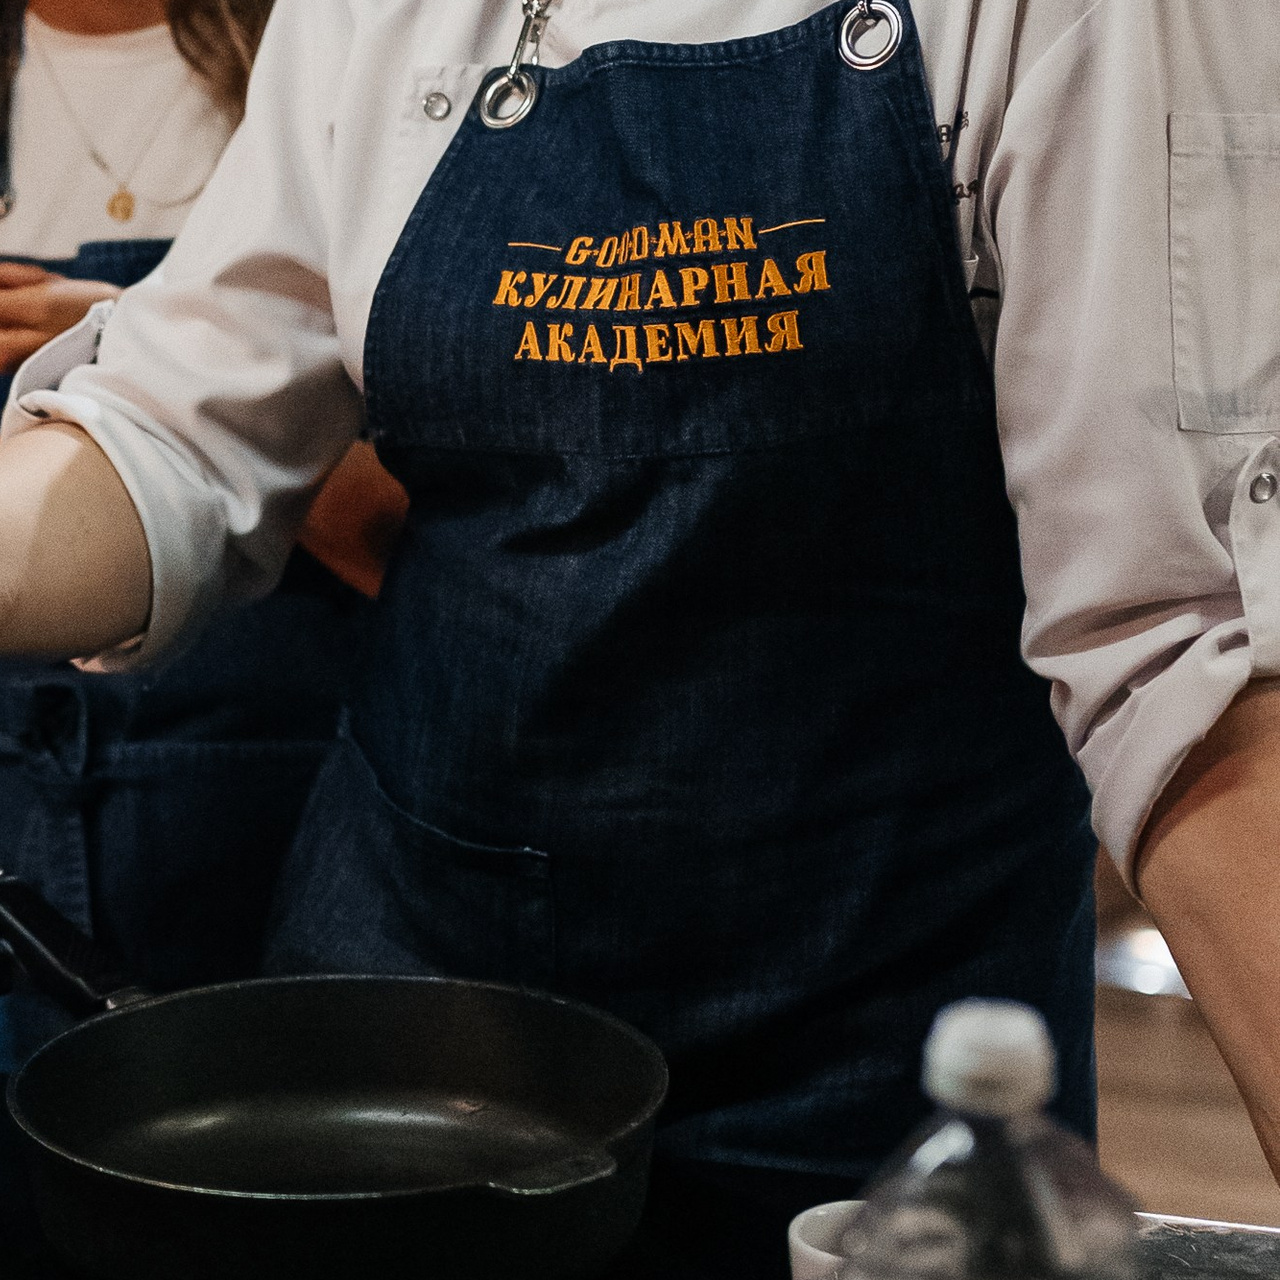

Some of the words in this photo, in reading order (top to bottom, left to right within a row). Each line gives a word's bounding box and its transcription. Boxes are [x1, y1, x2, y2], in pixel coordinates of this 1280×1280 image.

[565, 217, 757, 267] GOODMAN
[493, 250, 831, 311] КУЛИНАРНАЯ
[515, 310, 804, 373] АКАДЕМИЯ
